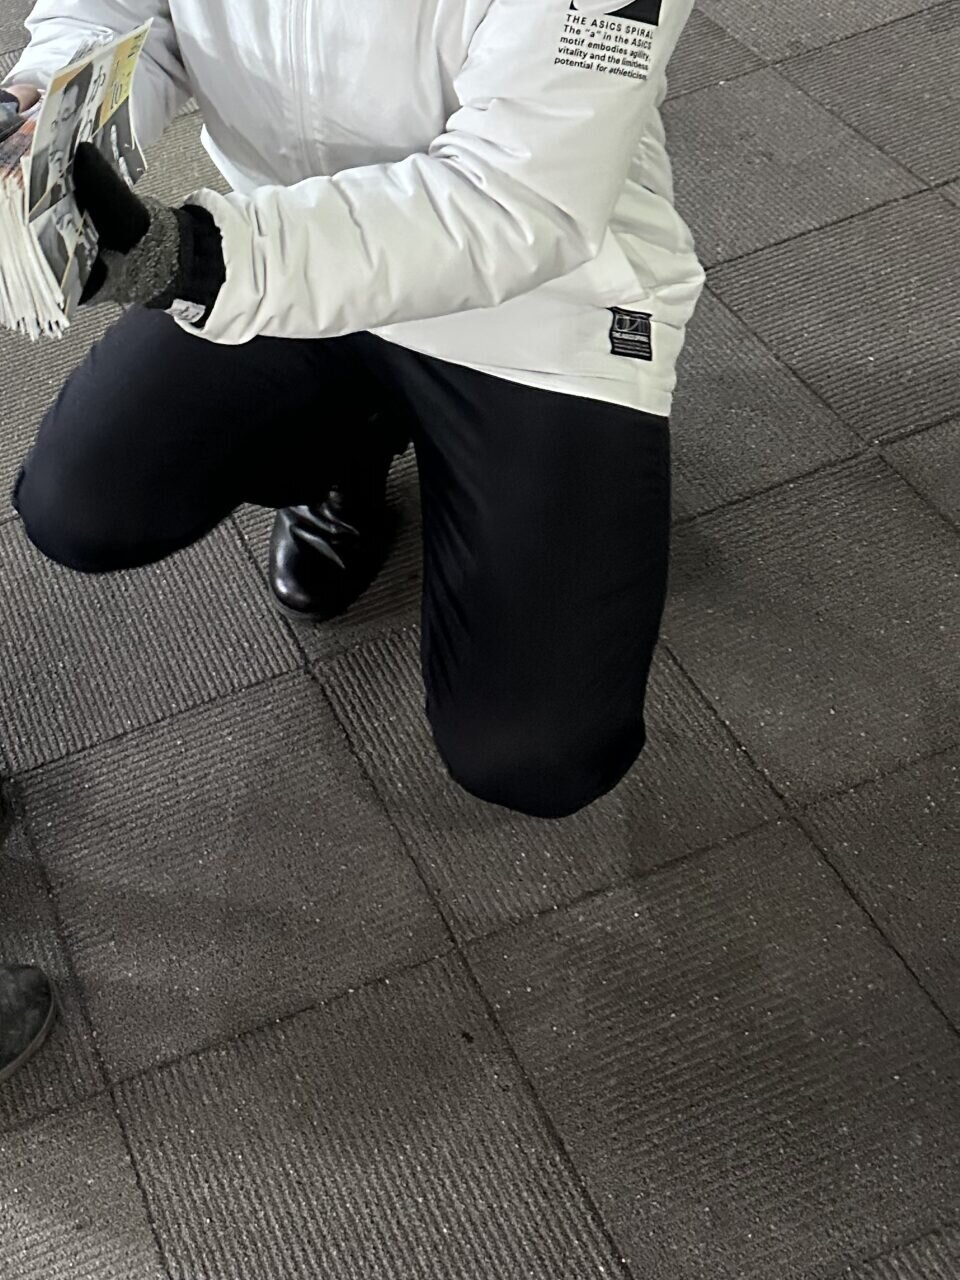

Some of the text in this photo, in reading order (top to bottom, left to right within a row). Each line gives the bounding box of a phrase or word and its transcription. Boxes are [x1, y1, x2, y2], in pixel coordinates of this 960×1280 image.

[564, 24, 581, 36] The
[602, 31, 612, 41] in
[614, 34, 629, 45] the
[566, 13, 653, 40] THE ASICS SPIRAL
[558, 46, 588, 60] vitality
[589, 53, 606, 62] and
[607, 55, 621, 66] the
[560, 36, 585, 47] motif
[587, 41, 628, 56] embodies
[554, 57, 594, 71] potential
[596, 63, 608, 73] for
